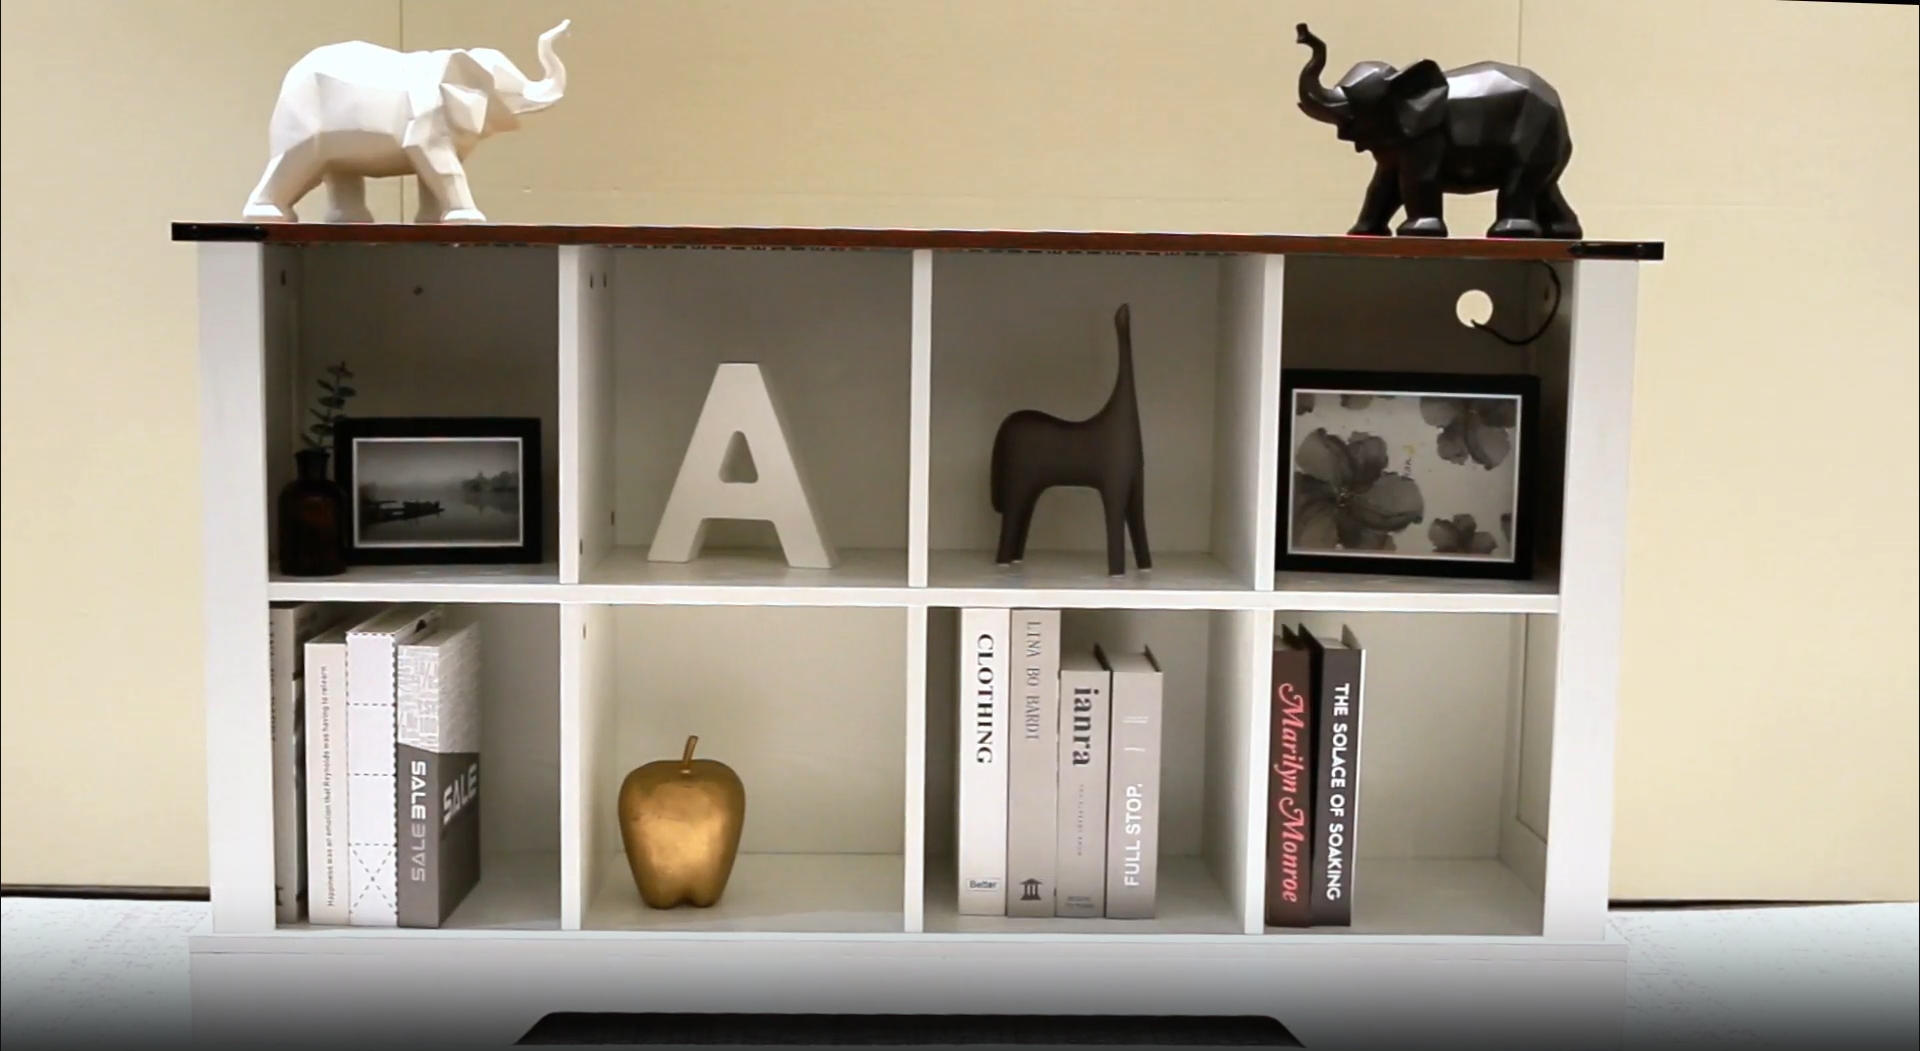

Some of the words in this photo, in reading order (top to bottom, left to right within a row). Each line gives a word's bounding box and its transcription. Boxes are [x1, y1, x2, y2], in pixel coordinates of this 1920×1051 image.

[647, 362, 835, 568] A
[1026, 621, 1042, 658] LINA
[320, 666, 329, 696] relearn
[1025, 667, 1042, 687] BO
[1333, 682, 1350, 715] THE
[321, 706, 331, 732] having
[976, 633, 995, 765] CLOTHING
[1025, 695, 1042, 741] BARDI
[322, 734, 331, 749] was
[1072, 687, 1100, 766] ianra
[1273, 682, 1306, 795] Marilyn
[322, 751, 332, 787] Reynolds
[1330, 723, 1348, 788] SOLACE
[323, 788, 332, 803] that
[411, 760, 427, 820] SALE
[443, 763, 479, 827] SALE
[1125, 782, 1143, 836] STOP.
[1329, 793, 1346, 816] OF
[325, 838, 333, 847] an
[326, 849, 334, 864] was
[411, 823, 426, 882] SALE
[1123, 841, 1142, 887] FULL
[1278, 796, 1306, 903] Monroe
[1326, 823, 1344, 901] SOAKING
[326, 866, 336, 907] Happiness
[969, 879, 998, 891] Better
